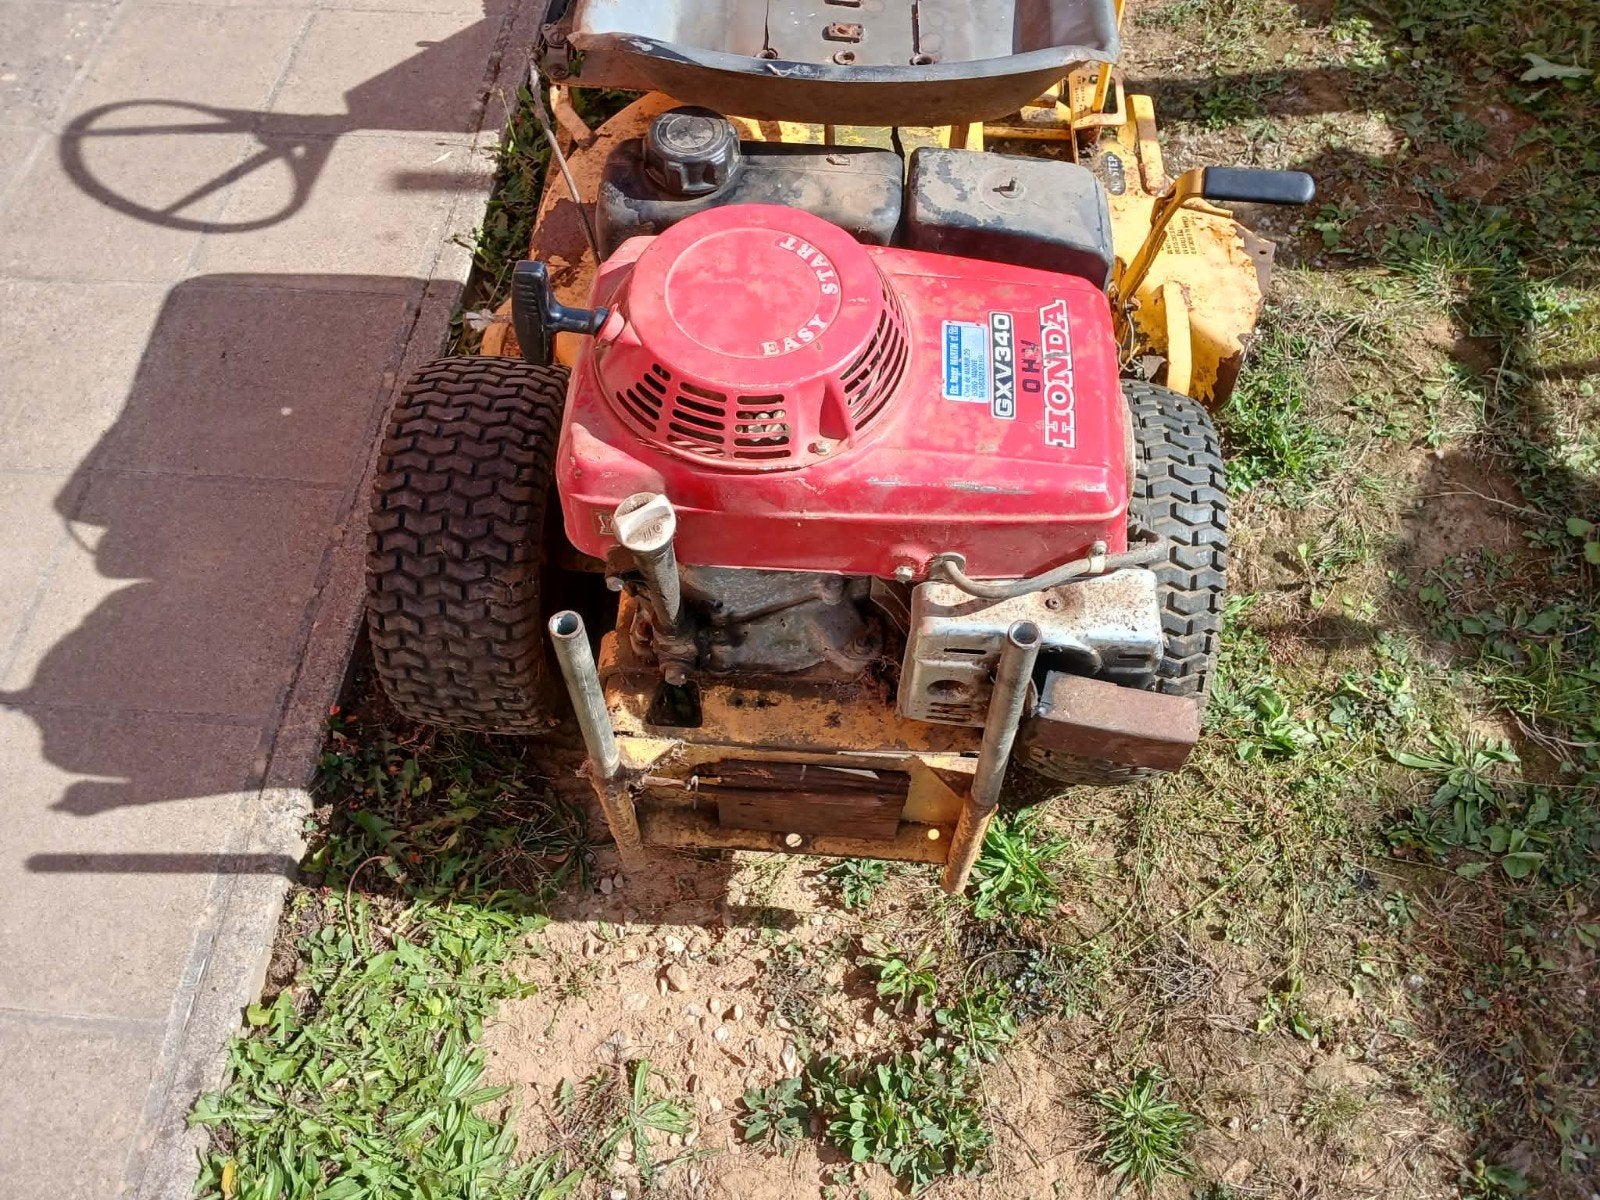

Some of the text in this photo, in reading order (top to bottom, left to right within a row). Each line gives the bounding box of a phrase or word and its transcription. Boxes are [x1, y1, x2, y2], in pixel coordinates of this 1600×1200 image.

[1107, 156, 1121, 192] NO STEP
[761, 237, 839, 356] EASY START
[994, 314, 1013, 416] GXV340
[1020, 340, 1040, 393] OHV
[1040, 300, 1076, 448] HONDA
